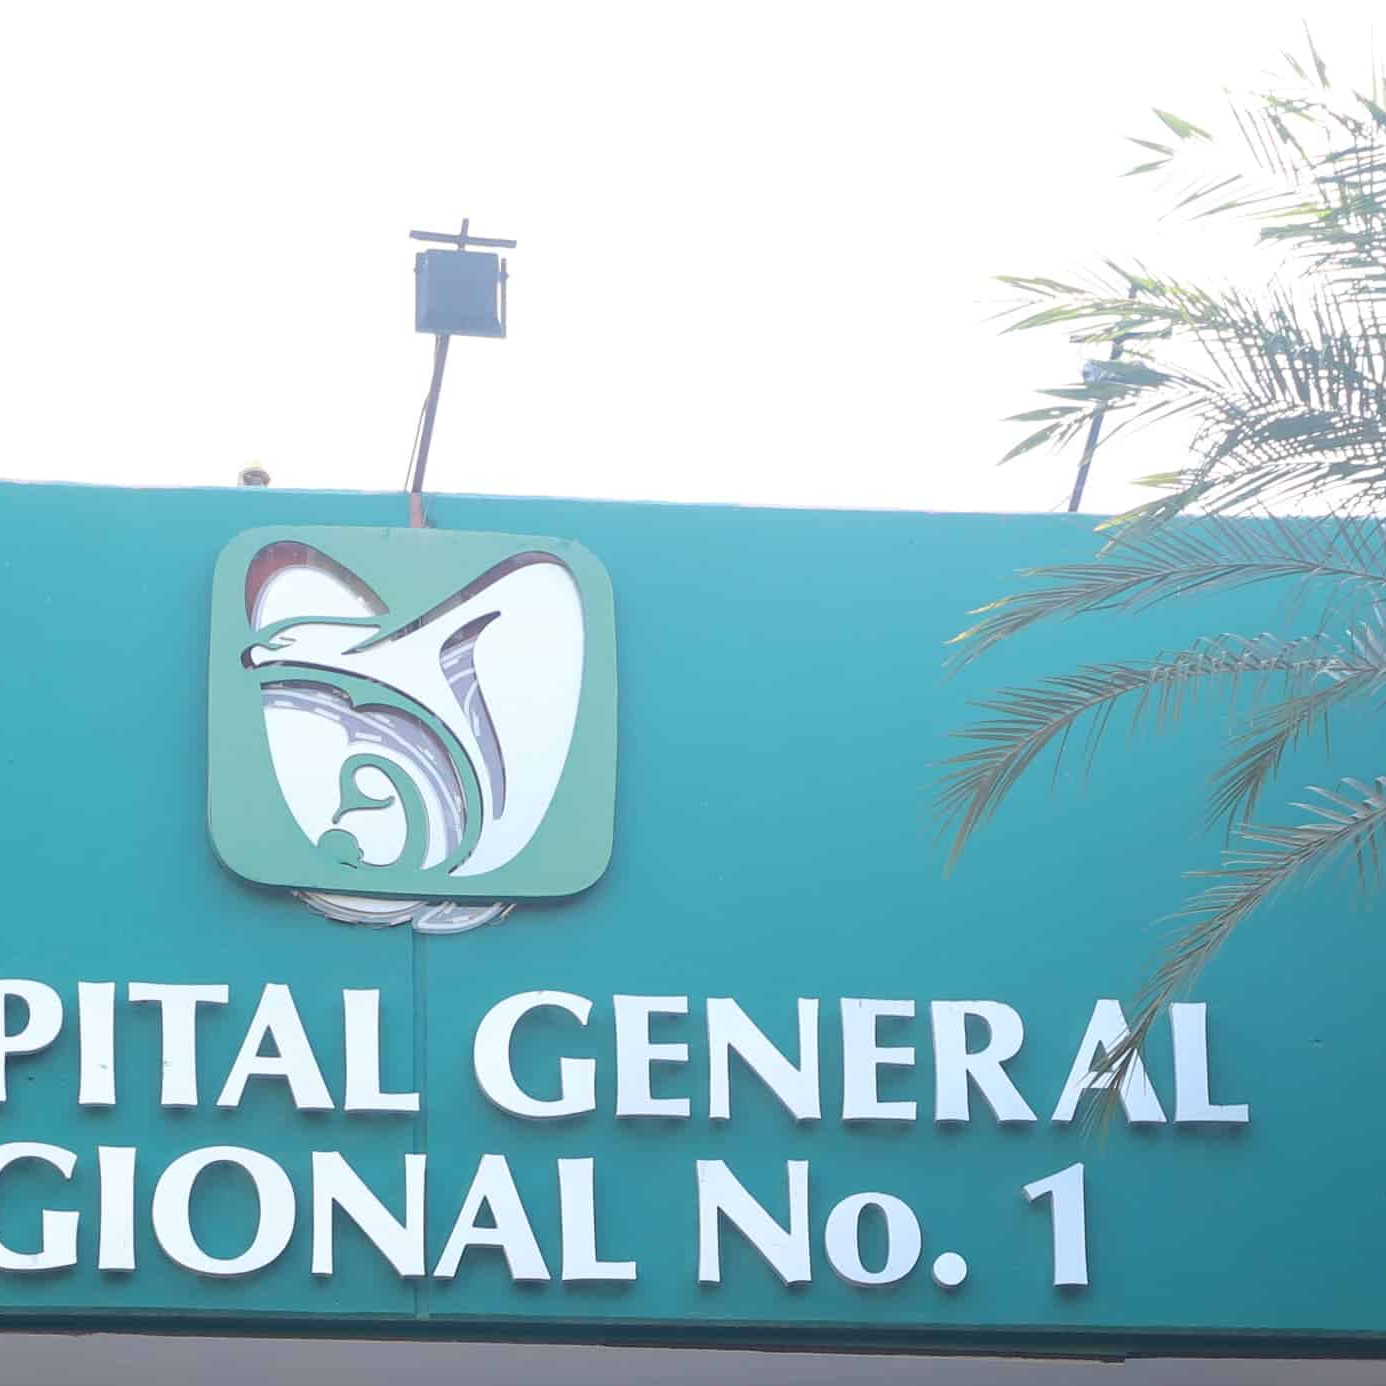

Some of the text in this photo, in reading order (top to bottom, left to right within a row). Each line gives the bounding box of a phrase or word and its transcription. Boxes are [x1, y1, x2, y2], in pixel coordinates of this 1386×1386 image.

[472, 989, 1251, 1124] GENERAL
[696, 1159, 969, 1288] No.
[1022, 1162, 1090, 1287] 1
